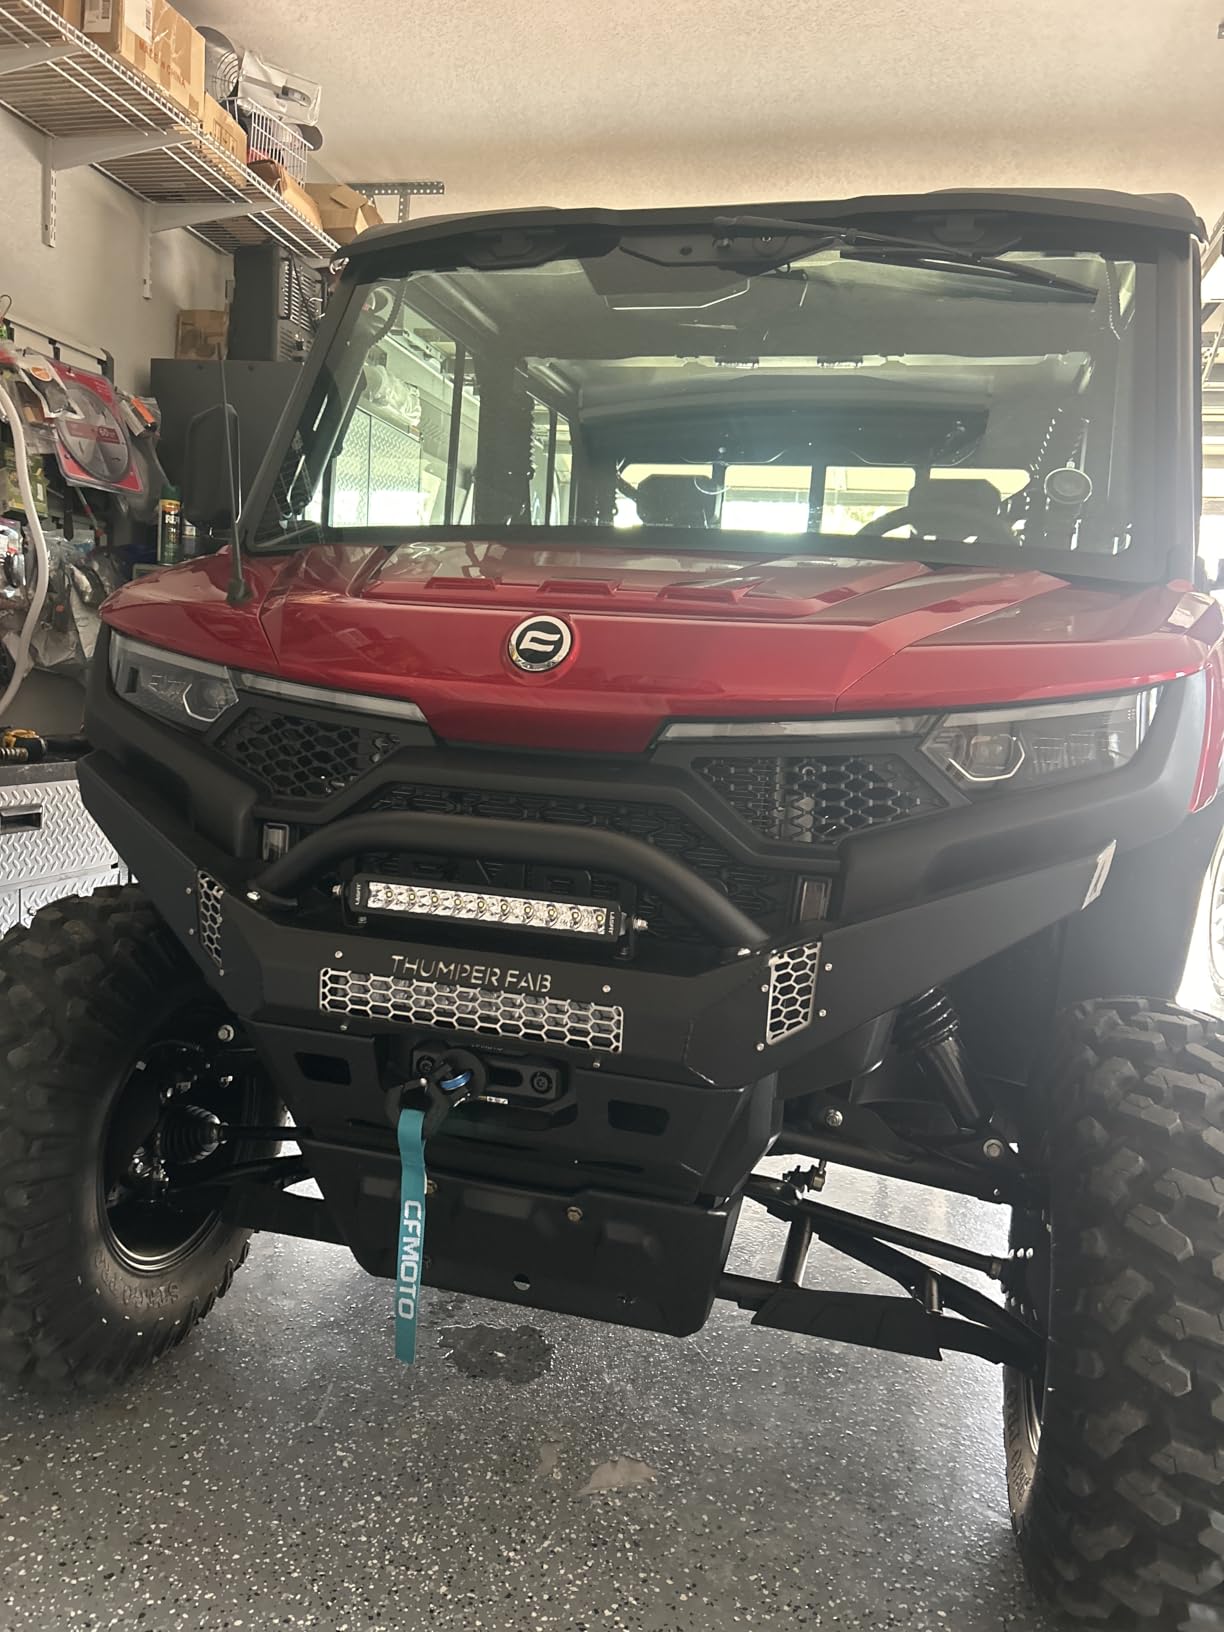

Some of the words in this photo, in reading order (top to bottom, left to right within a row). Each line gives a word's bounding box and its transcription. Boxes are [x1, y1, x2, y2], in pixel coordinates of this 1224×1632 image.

[391, 954, 500, 987] THUMPER
[504, 969, 552, 992] FAB
[398, 1199, 423, 1320] CFMOTO
